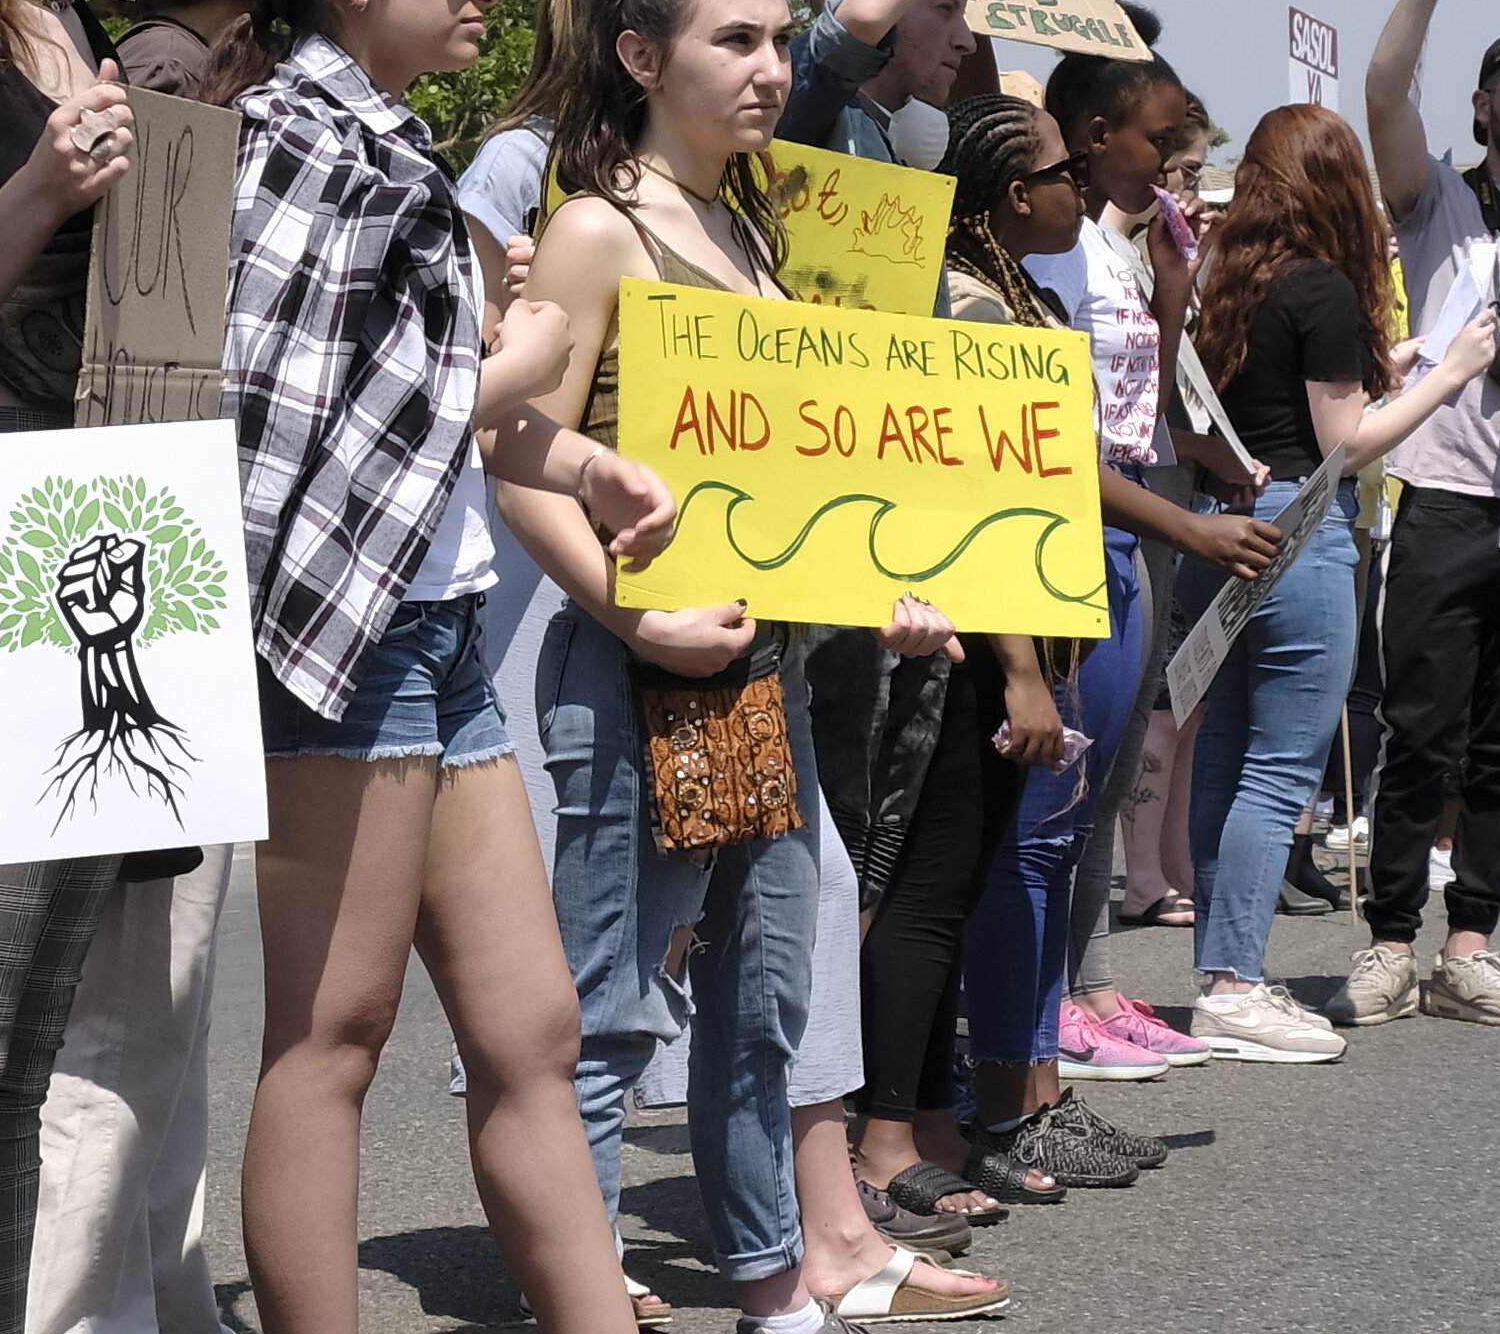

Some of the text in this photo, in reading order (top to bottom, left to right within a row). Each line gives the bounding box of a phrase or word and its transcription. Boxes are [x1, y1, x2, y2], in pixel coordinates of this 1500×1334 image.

[985, 2, 1135, 48] STRUGGLE
[1292, 12, 1335, 75] SASOL
[647, 294, 1071, 386] THE OCEANS ARE RISING
[669, 385, 771, 456] AND
[795, 398, 857, 458] SO
[877, 403, 964, 467] ARE
[979, 401, 1073, 478] WE
